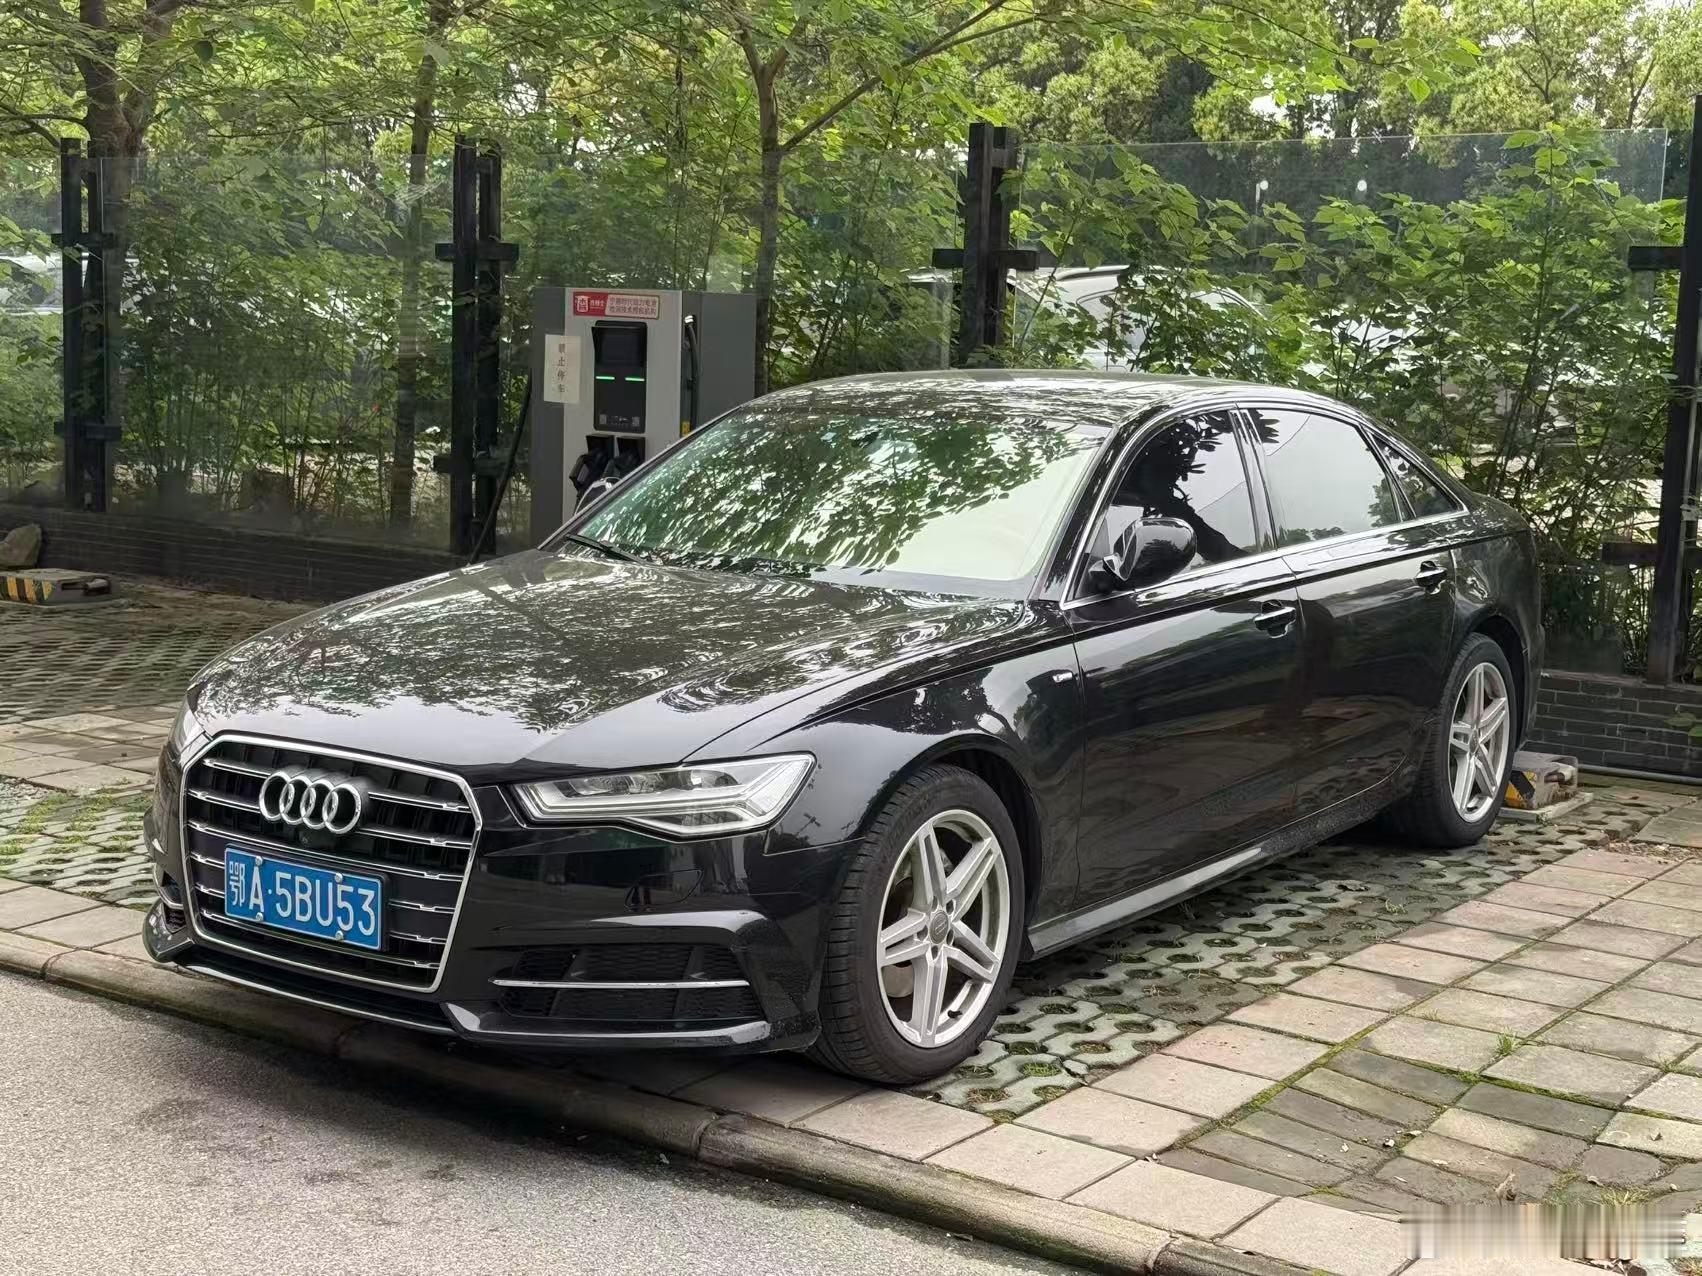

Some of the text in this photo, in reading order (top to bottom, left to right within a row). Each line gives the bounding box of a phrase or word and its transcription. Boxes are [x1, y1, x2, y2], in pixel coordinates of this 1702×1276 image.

[609, 297, 657, 307] 宁时代力电
